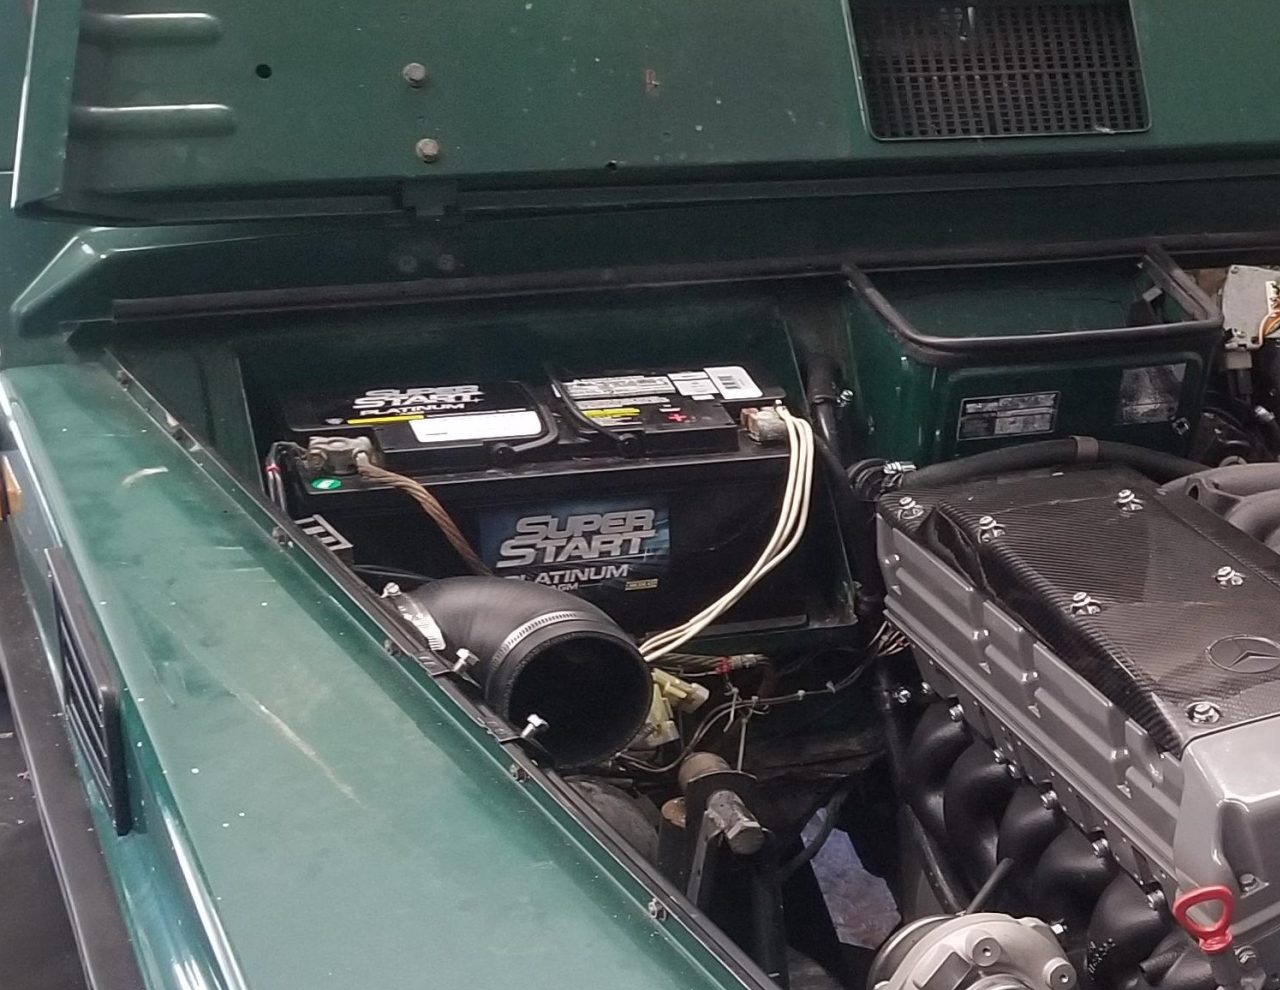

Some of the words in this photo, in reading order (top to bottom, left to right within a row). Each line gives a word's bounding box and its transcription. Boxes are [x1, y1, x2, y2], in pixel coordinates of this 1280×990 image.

[352, 392, 485, 409] START
[365, 385, 479, 398] SUPER
[360, 403, 465, 416] PLATINUM
[513, 508, 656, 543] SUPER
[496, 529, 657, 568] START
[503, 563, 629, 585] ATINUM
